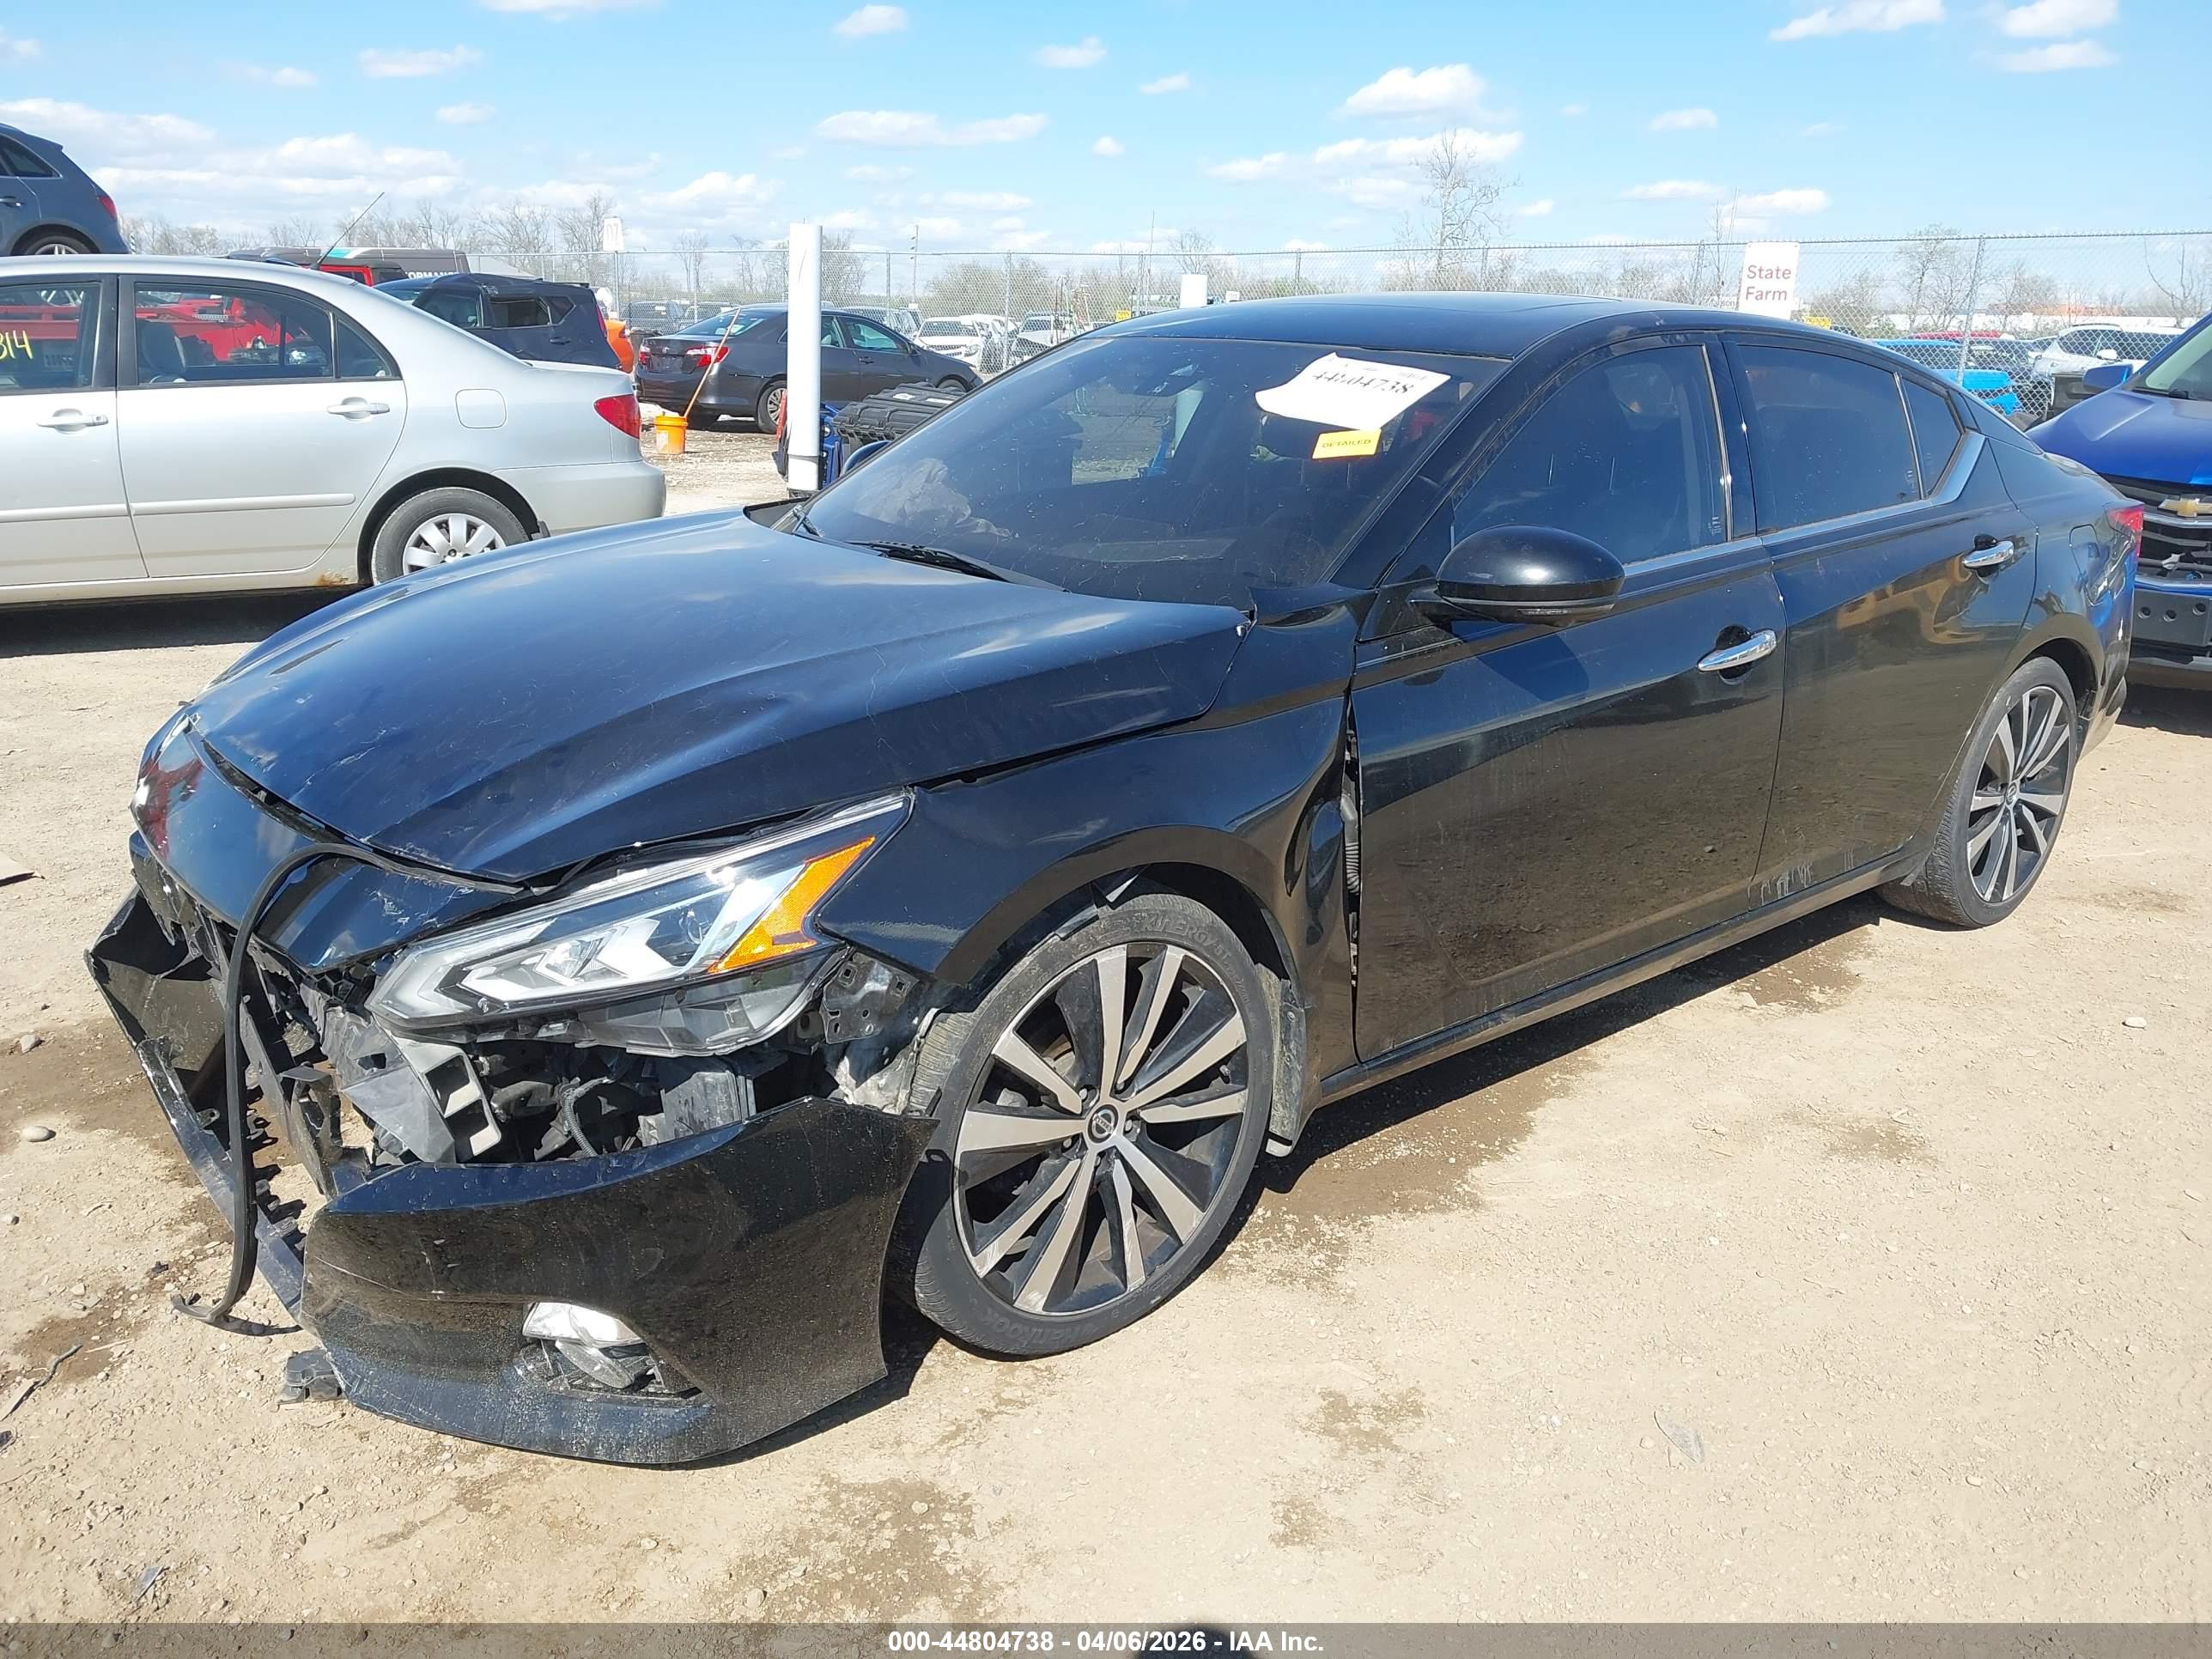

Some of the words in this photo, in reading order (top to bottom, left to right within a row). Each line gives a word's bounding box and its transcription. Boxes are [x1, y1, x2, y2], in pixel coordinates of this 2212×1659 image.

[1747, 264, 1792, 280] State
[1745, 286, 1788, 301] Farm
[1322, 439, 1372, 448] DETAILED
